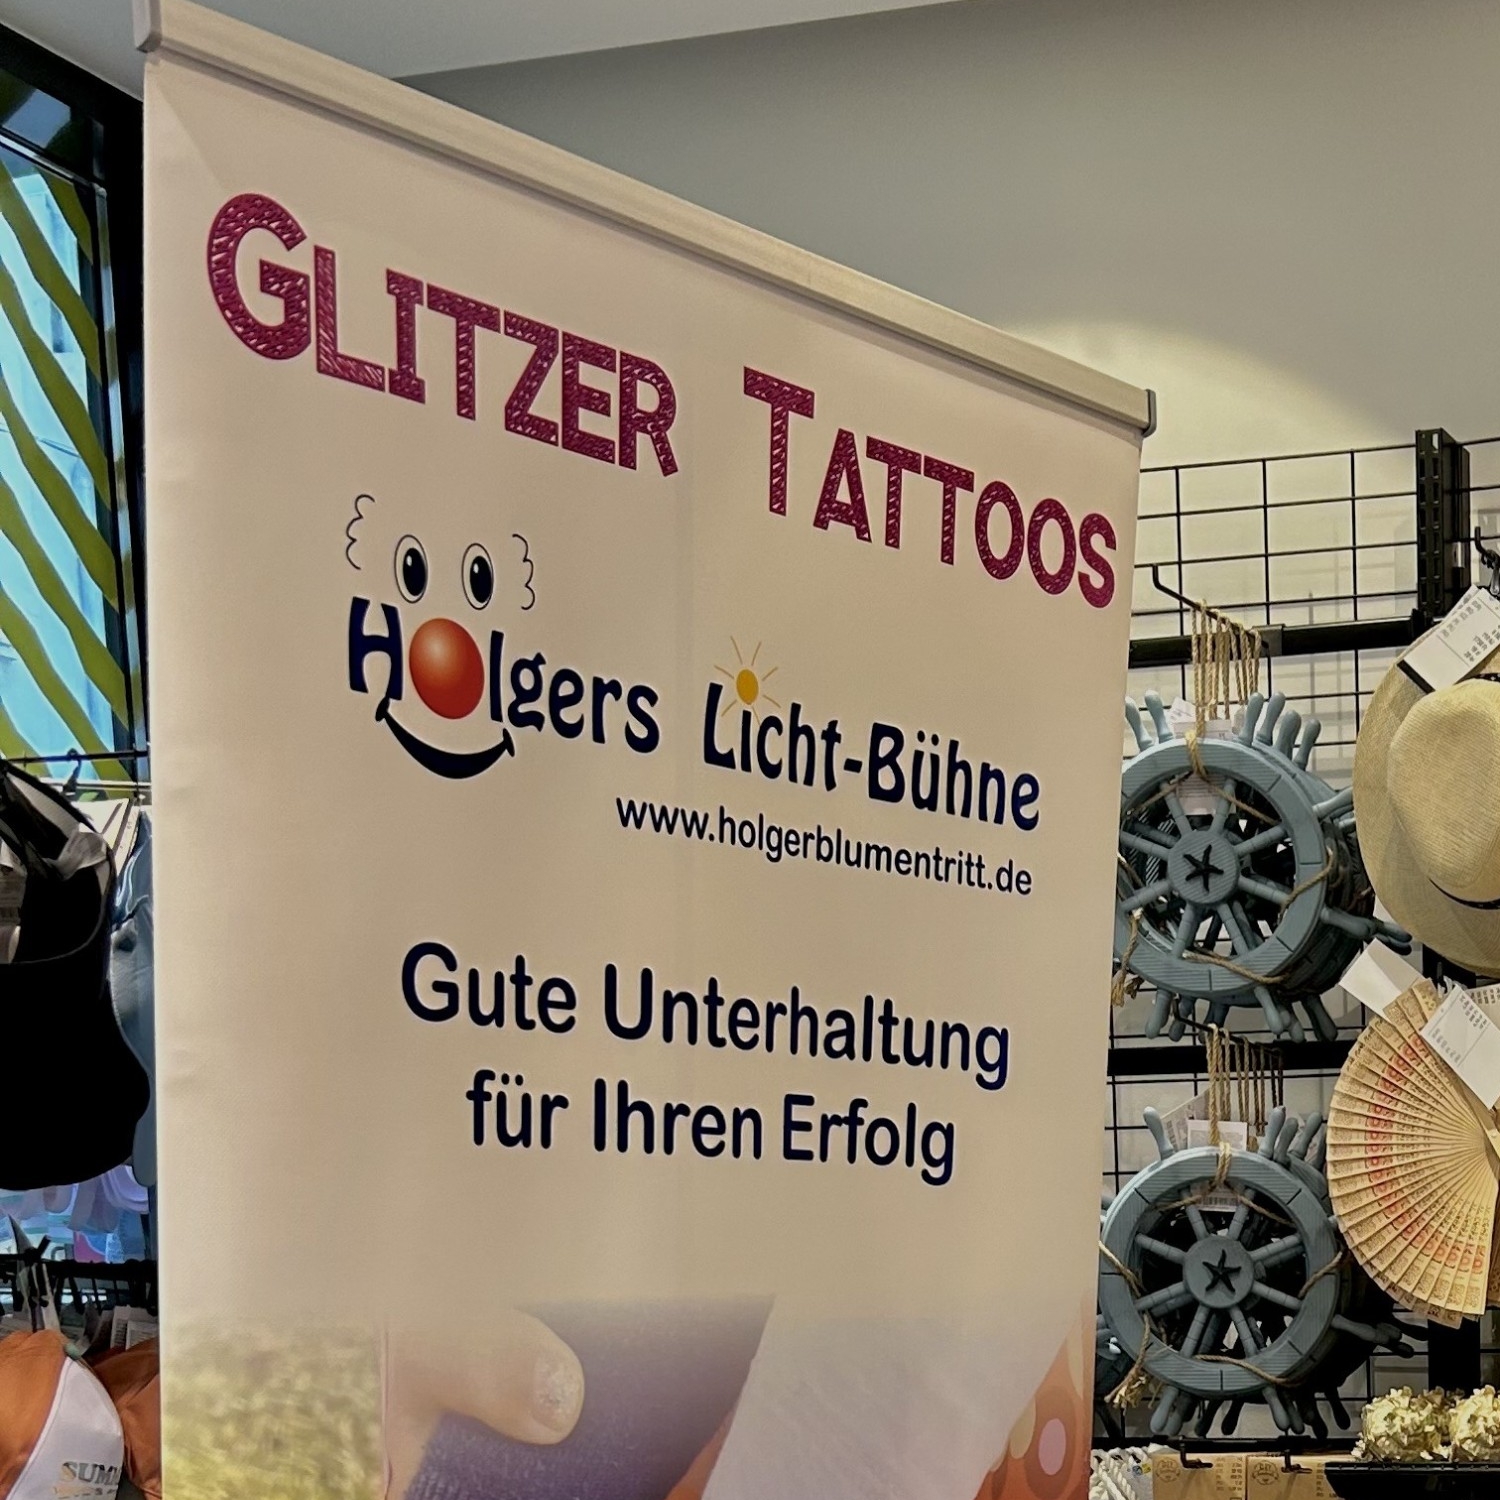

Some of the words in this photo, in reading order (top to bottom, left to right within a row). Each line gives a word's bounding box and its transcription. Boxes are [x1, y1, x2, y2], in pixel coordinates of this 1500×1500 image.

[207, 193, 679, 478] GLITZER
[743, 366, 1117, 609] TATTOOS
[702, 680, 1040, 832] Licht-Bühne
[615, 796, 1034, 896] www.holgerblumentritt.de
[401, 941, 577, 1034] Gute
[603, 962, 1010, 1091] Unterhaltung
[466, 1069, 570, 1150] für
[593, 1078, 763, 1160] Ihren
[782, 1093, 956, 1187] Erfolg
